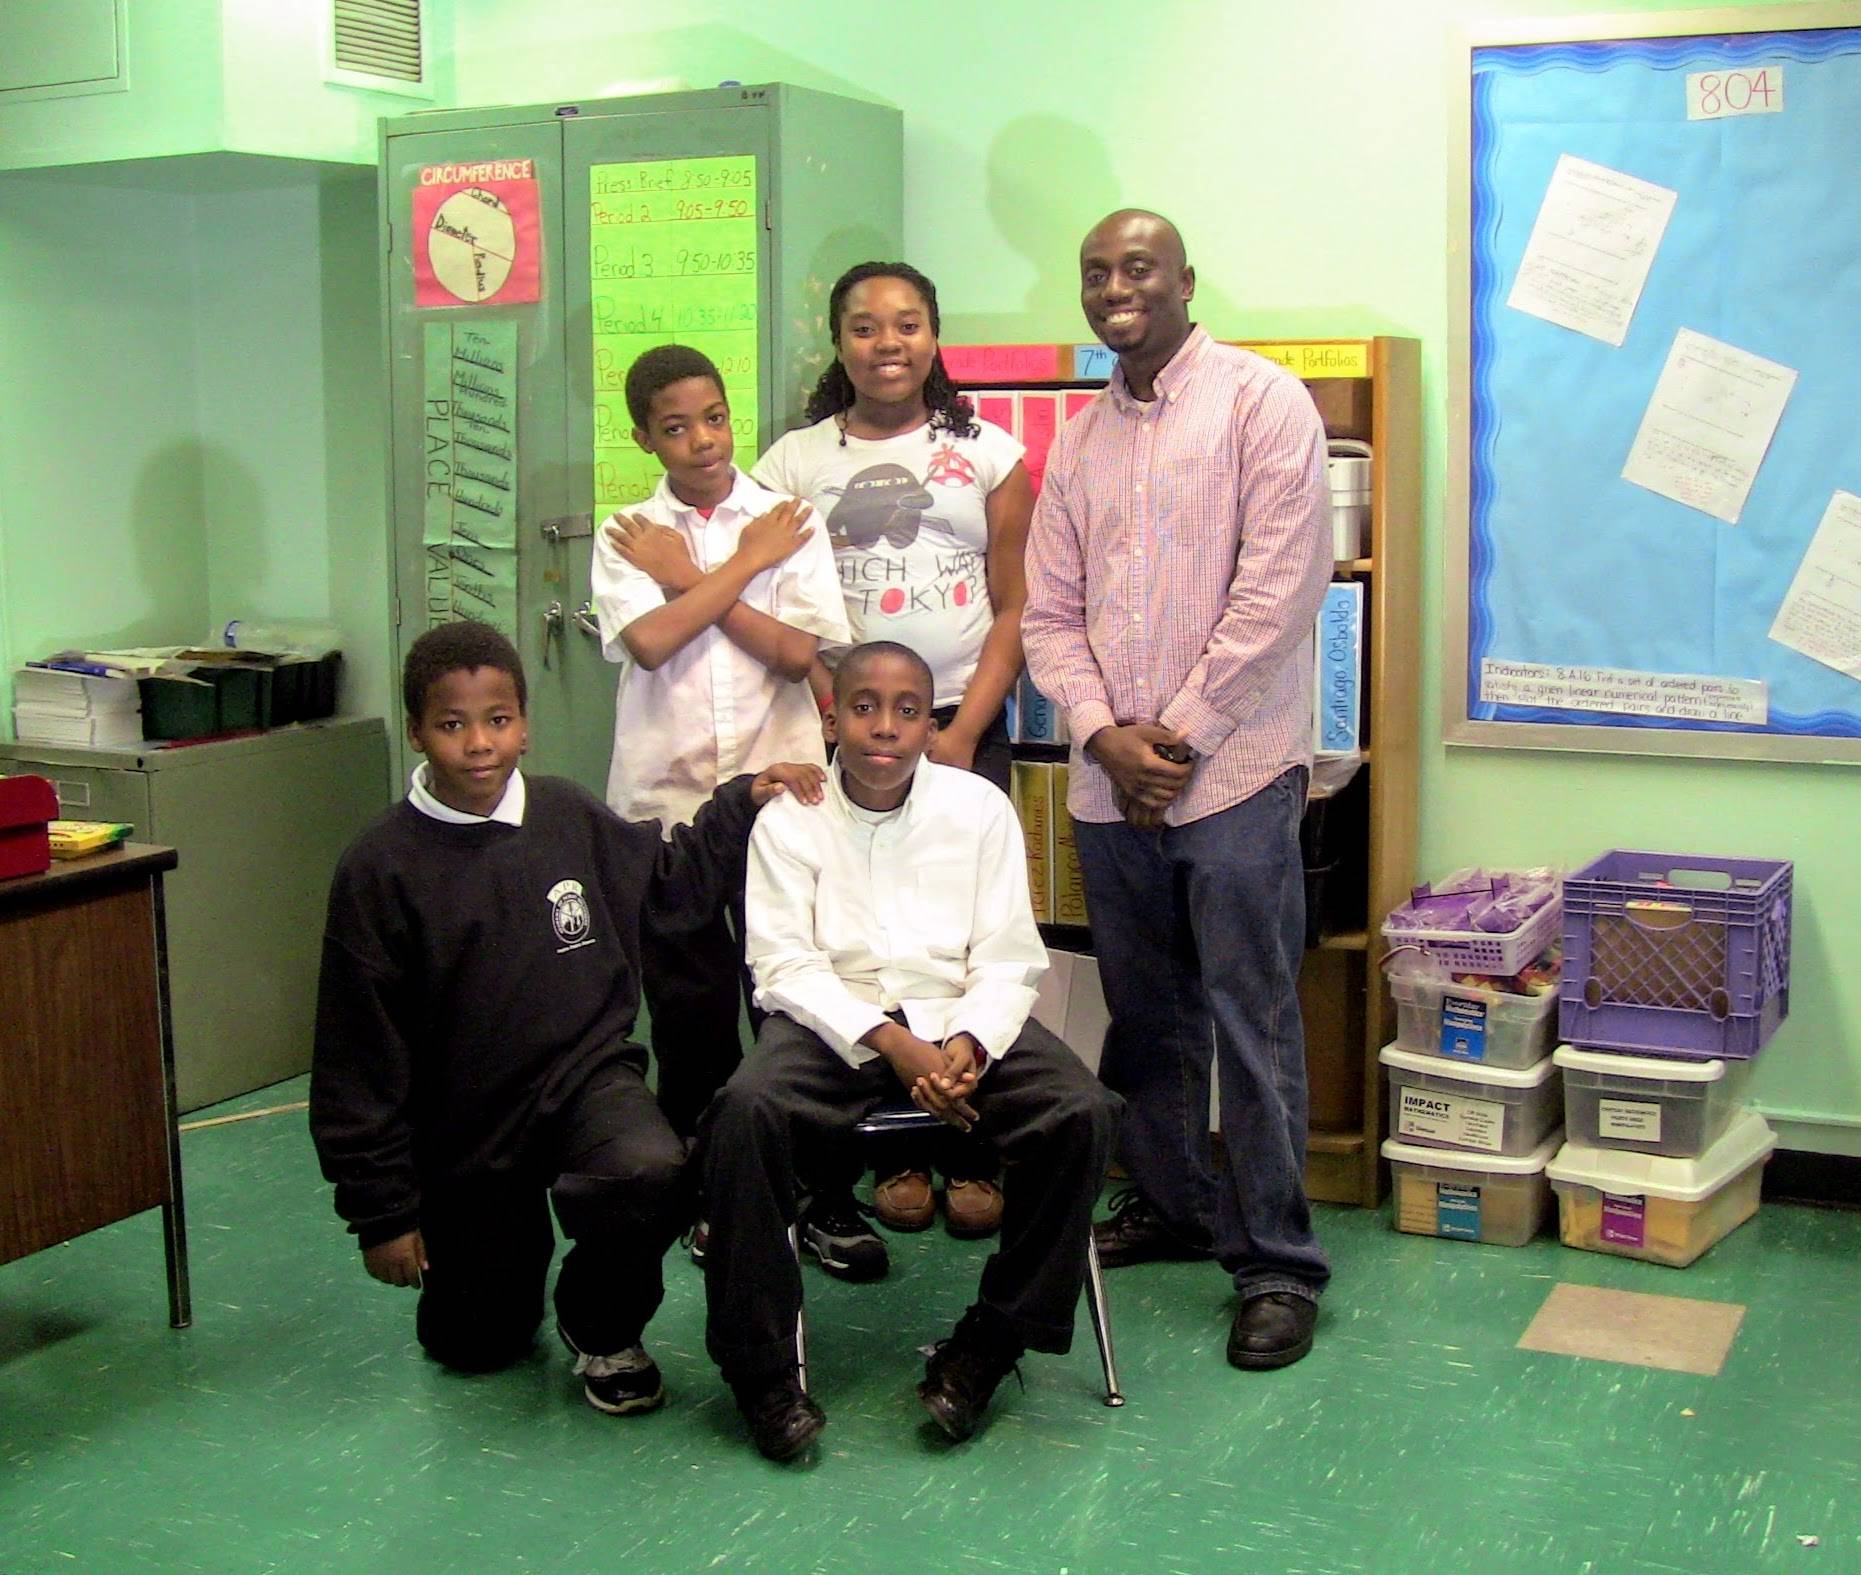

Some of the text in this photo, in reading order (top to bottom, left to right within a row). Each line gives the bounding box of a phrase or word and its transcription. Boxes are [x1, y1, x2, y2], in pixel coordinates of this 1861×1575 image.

[1699, 70, 1776, 115] 804
[420, 160, 532, 186] CIRCUMFERENCE
[641, 204, 653, 222] 2
[641, 253, 654, 277] 3
[651, 307, 664, 331] 4
[1080, 348, 1108, 377] 7th
[1303, 347, 1358, 371] Portfolios
[426, 399, 451, 499] PLACE
[839, 556, 906, 584] ICH
[1404, 1095, 1452, 1113] IMPACT
